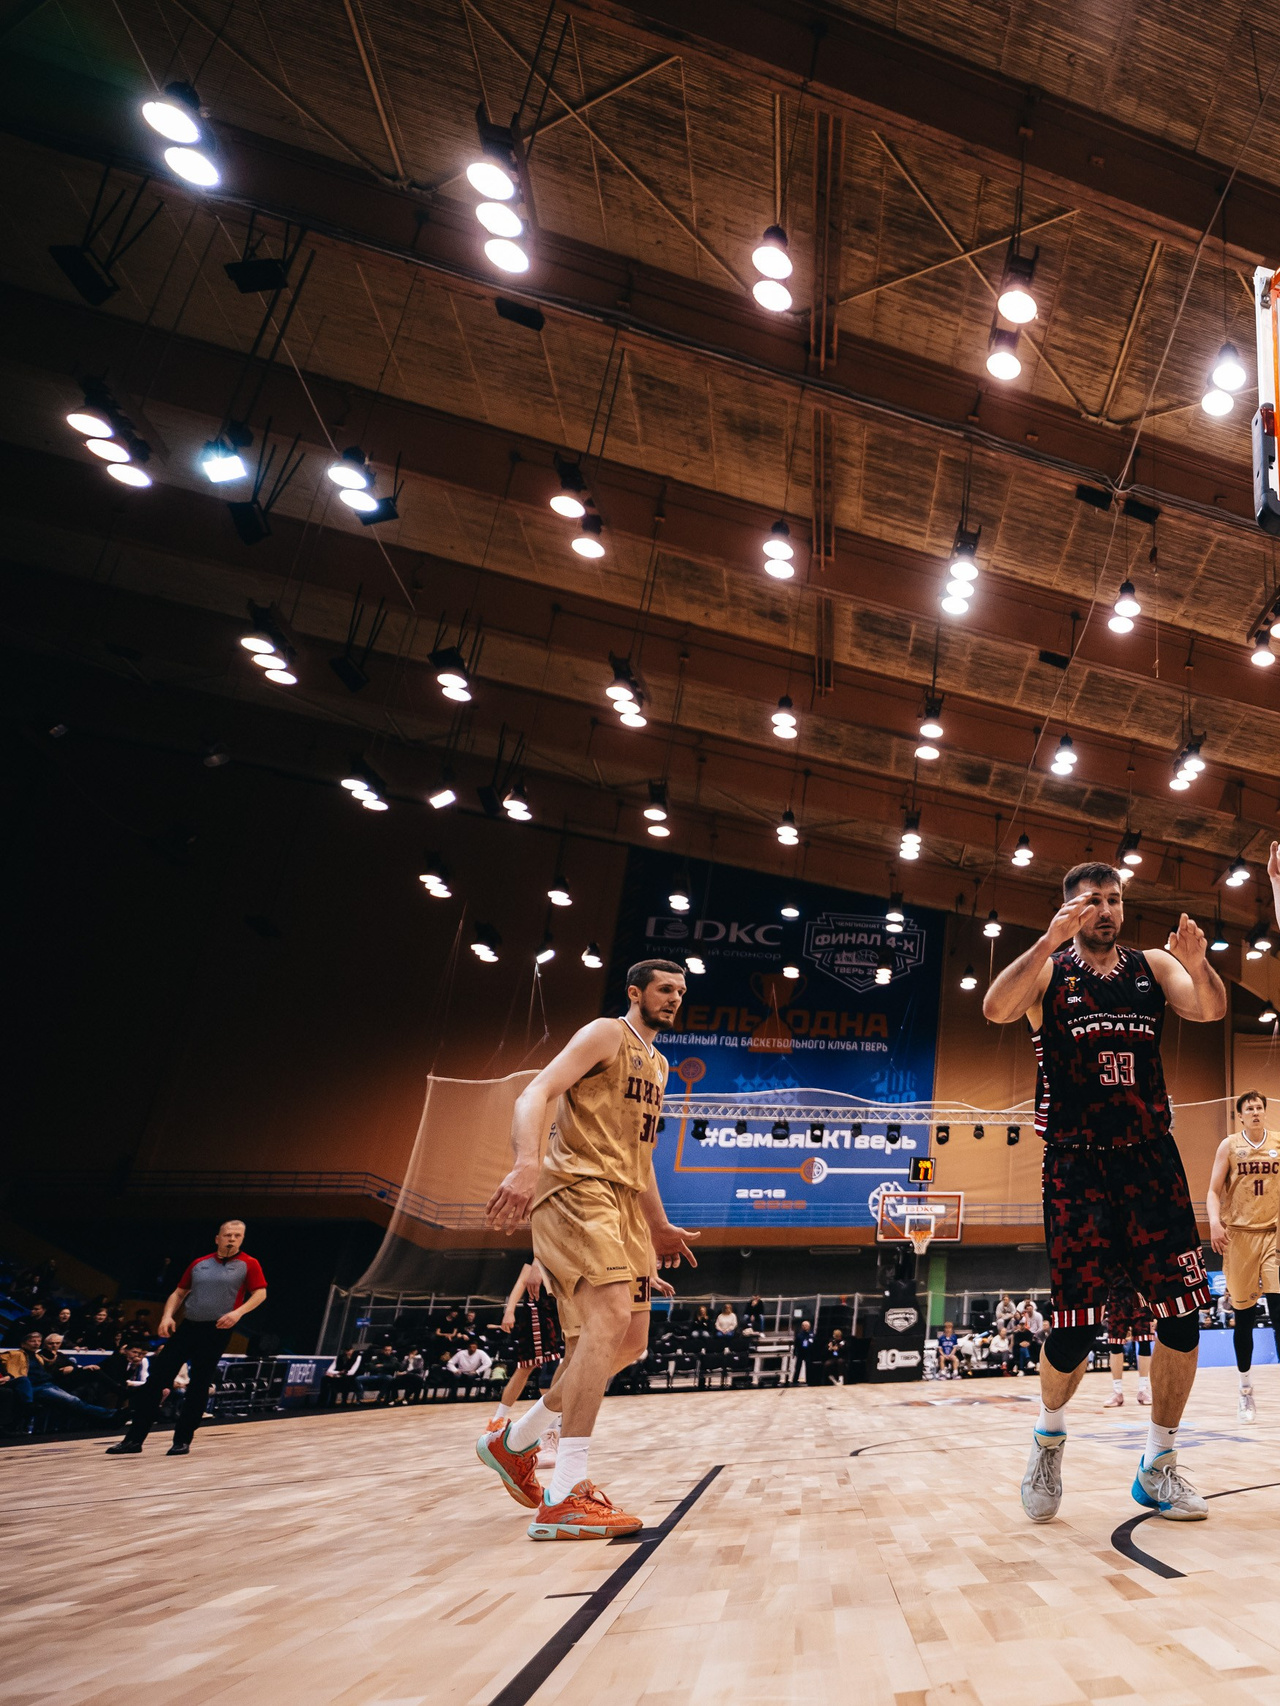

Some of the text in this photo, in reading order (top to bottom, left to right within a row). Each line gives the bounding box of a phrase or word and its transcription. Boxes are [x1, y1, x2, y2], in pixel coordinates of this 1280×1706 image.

[693, 919, 784, 946] DKC
[835, 921, 880, 930] ЧЕМПИОНАТ
[814, 932, 882, 946] ФИНАЛ
[645, 943, 720, 956] Титульй
[834, 966, 865, 975] ТВЕРЬ
[786, 1008, 889, 1038] ОДНА
[1070, 1021, 1155, 1043] РЯЗАНЬ
[719, 1036, 739, 1048] ГОД
[740, 1036, 826, 1050] БАСКЕТБОЛЬНОГО
[826, 1040, 858, 1051] КЛУБА
[859, 1041, 889, 1052] ТВЕРЬ
[1098, 1050, 1135, 1087] 33
[640, 1112, 657, 1143] 31
[1237, 1161, 1280, 1176] ЦИВС
[1254, 1179, 1264, 1196] 11
[634, 1275, 650, 1303] 31
